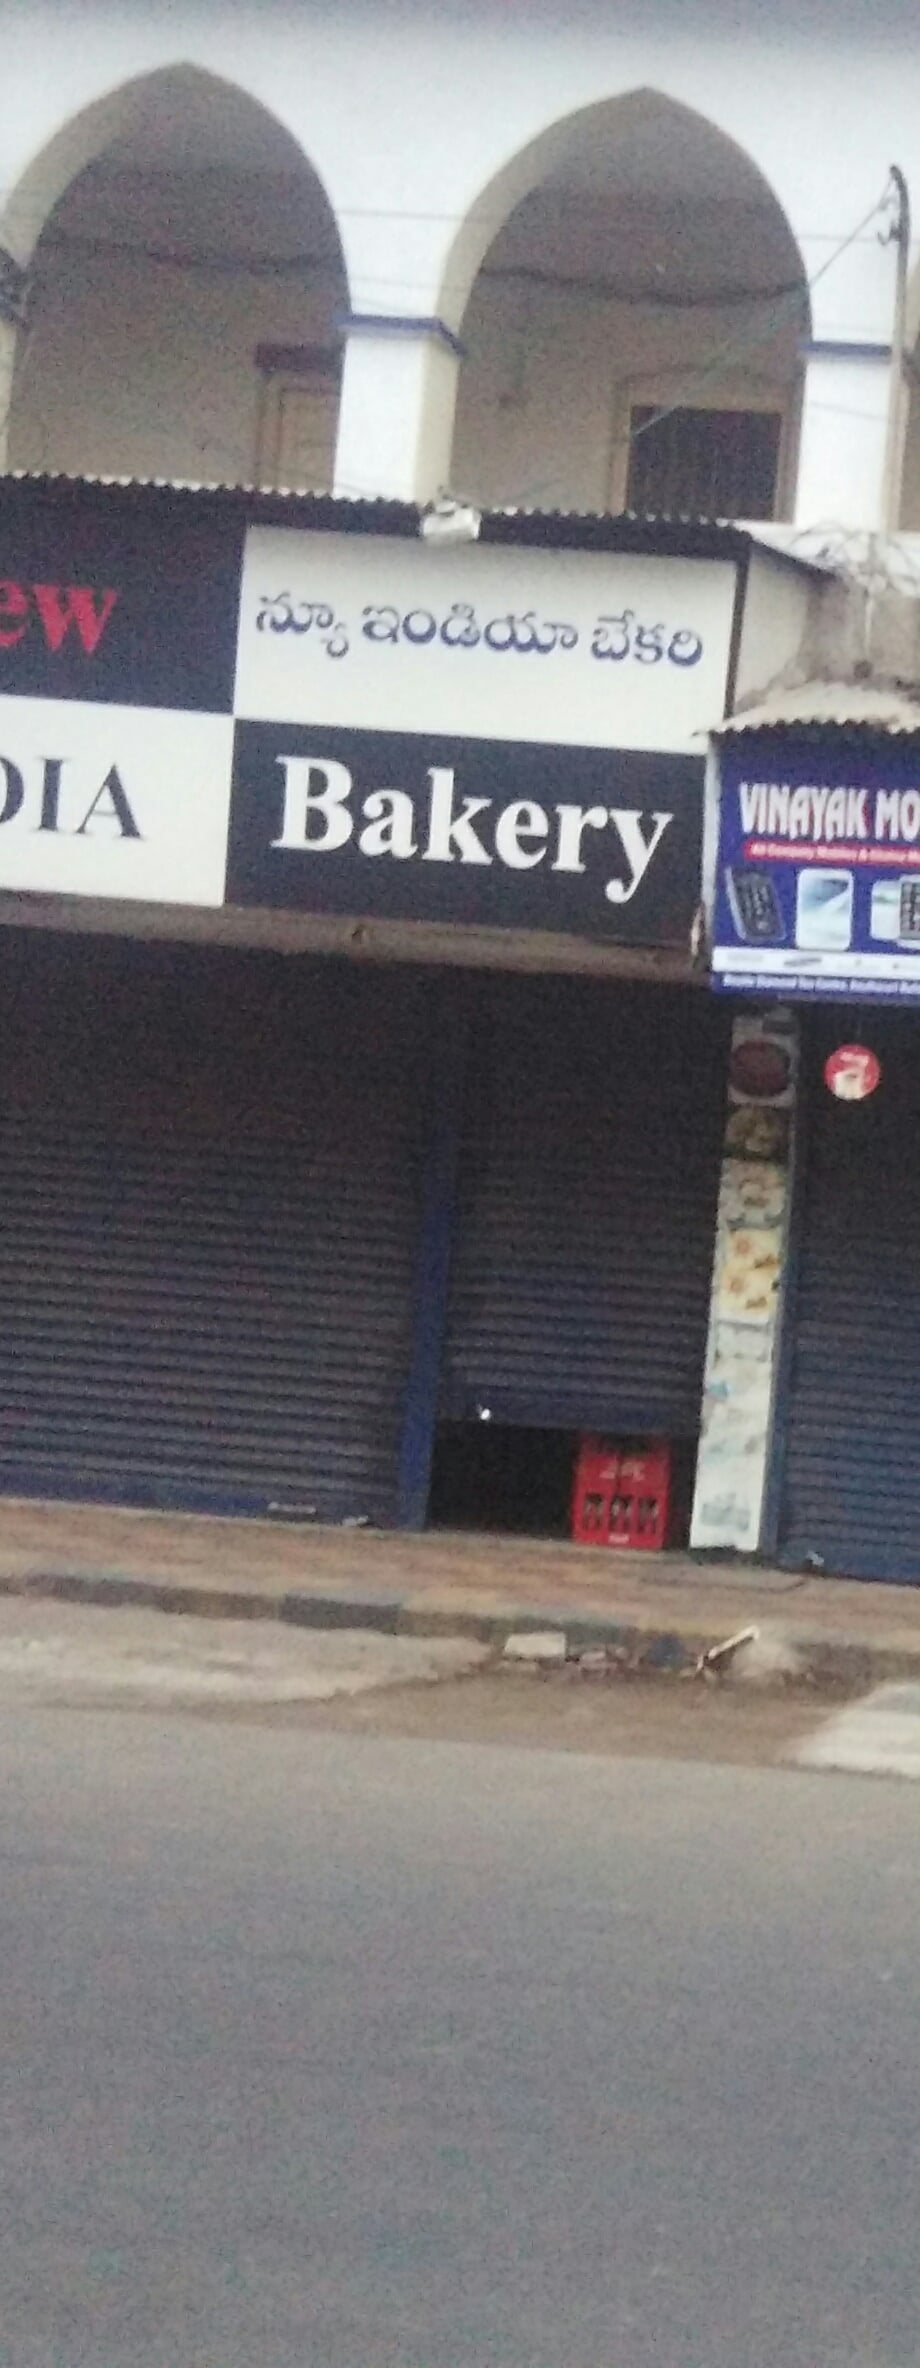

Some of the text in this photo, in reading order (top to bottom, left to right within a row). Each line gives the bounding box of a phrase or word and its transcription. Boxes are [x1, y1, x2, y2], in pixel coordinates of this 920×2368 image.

[256, 592, 704, 667] న్యూ ఇండియా బేకరి
[271, 755, 674, 903] Bakery
[739, 781, 920, 841] VINAYAK MO
